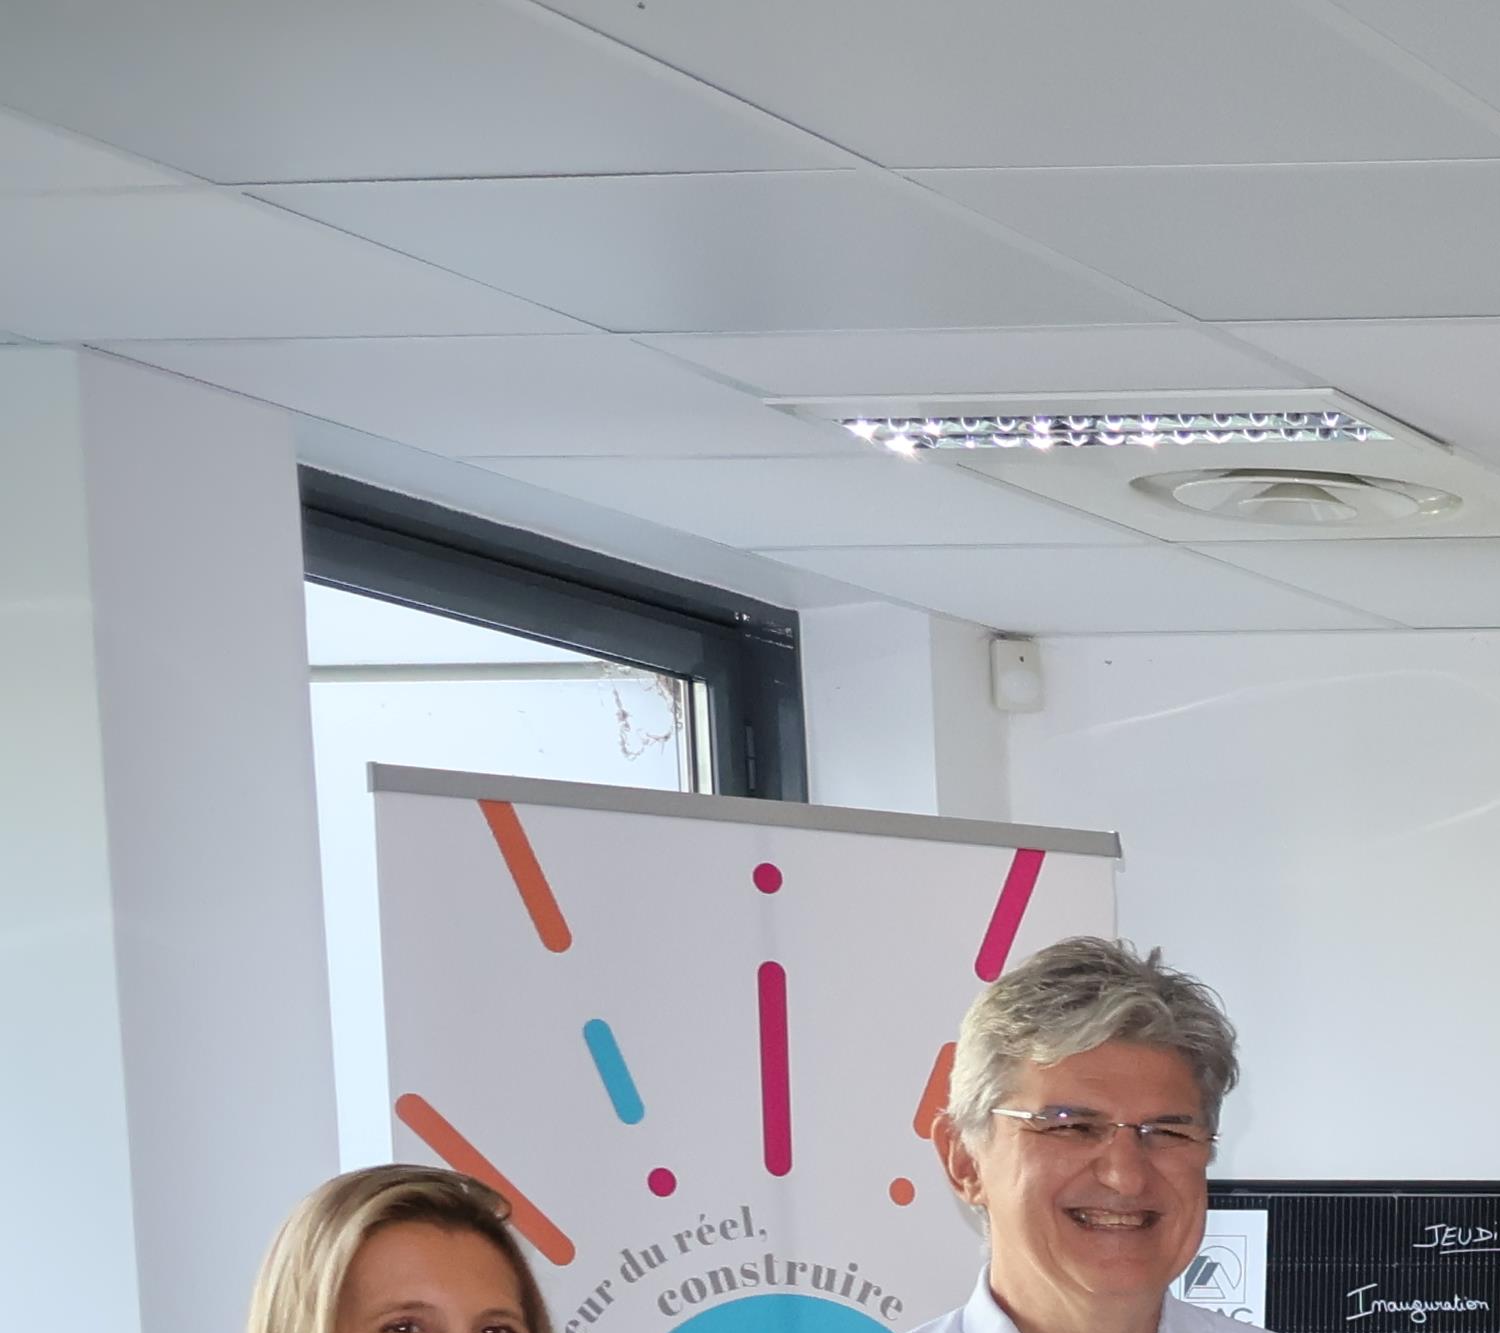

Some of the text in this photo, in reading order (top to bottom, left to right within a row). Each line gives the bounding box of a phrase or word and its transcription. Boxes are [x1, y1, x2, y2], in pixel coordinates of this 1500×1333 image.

[620, 1244, 668, 1284] du
[672, 1205, 768, 1256] réel,
[656, 1252, 904, 1322] construire
[1346, 1283, 1490, 1324] Inauguration
